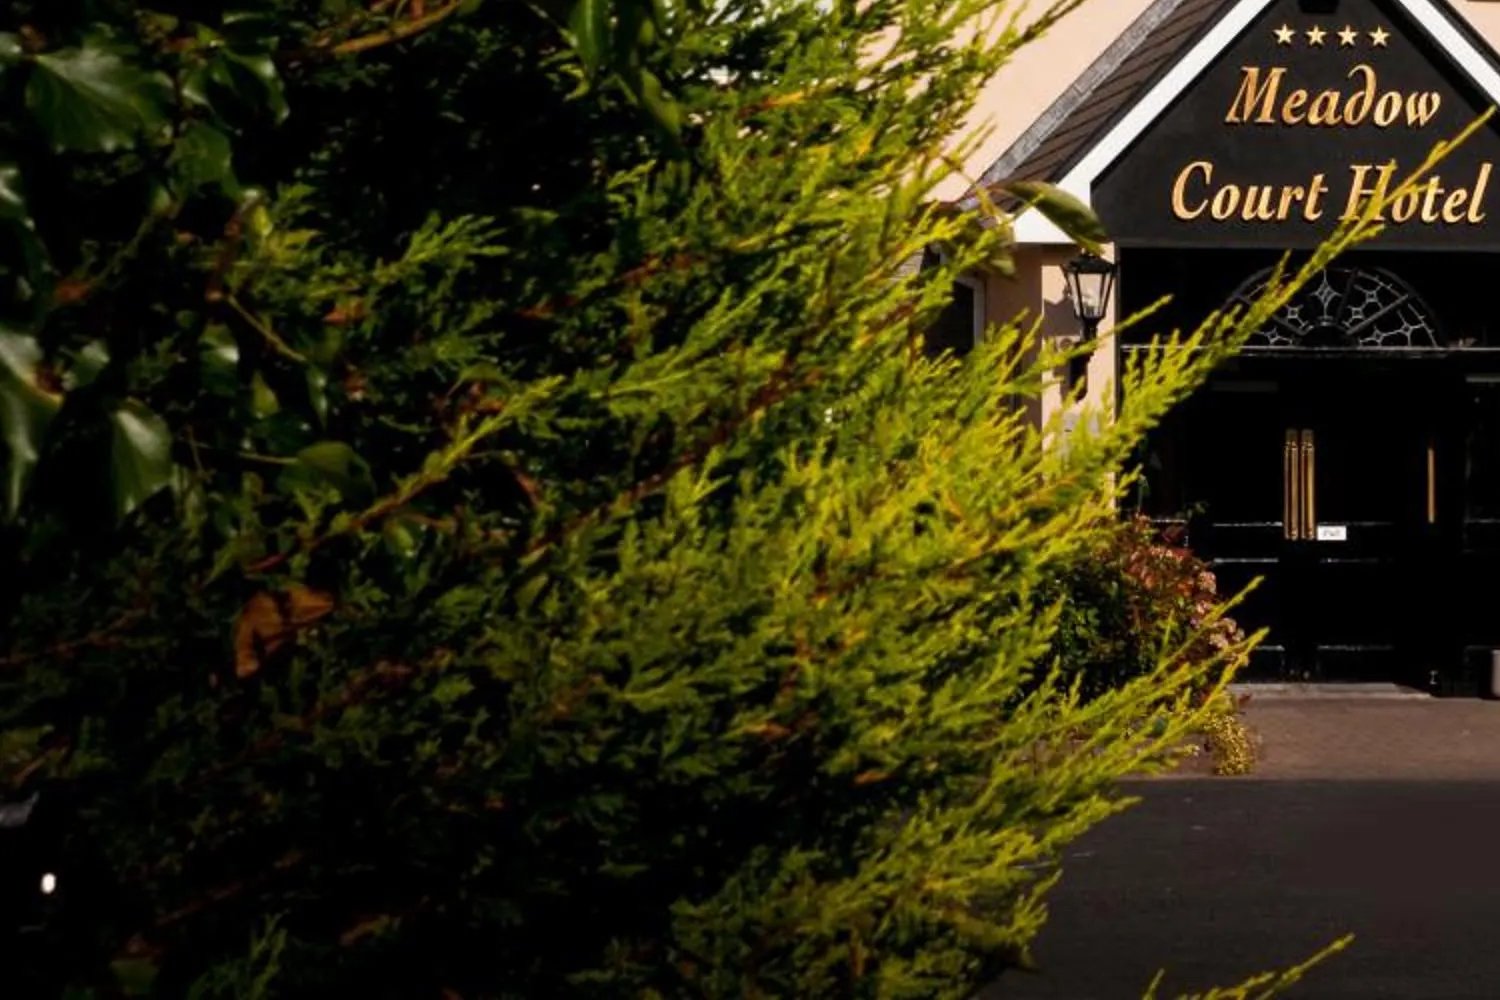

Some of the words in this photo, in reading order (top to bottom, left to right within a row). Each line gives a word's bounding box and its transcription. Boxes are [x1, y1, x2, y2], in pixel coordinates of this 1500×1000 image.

[1224, 64, 1442, 127] Meadow
[1171, 161, 1329, 222] Court
[1337, 162, 1493, 223] Hotel
